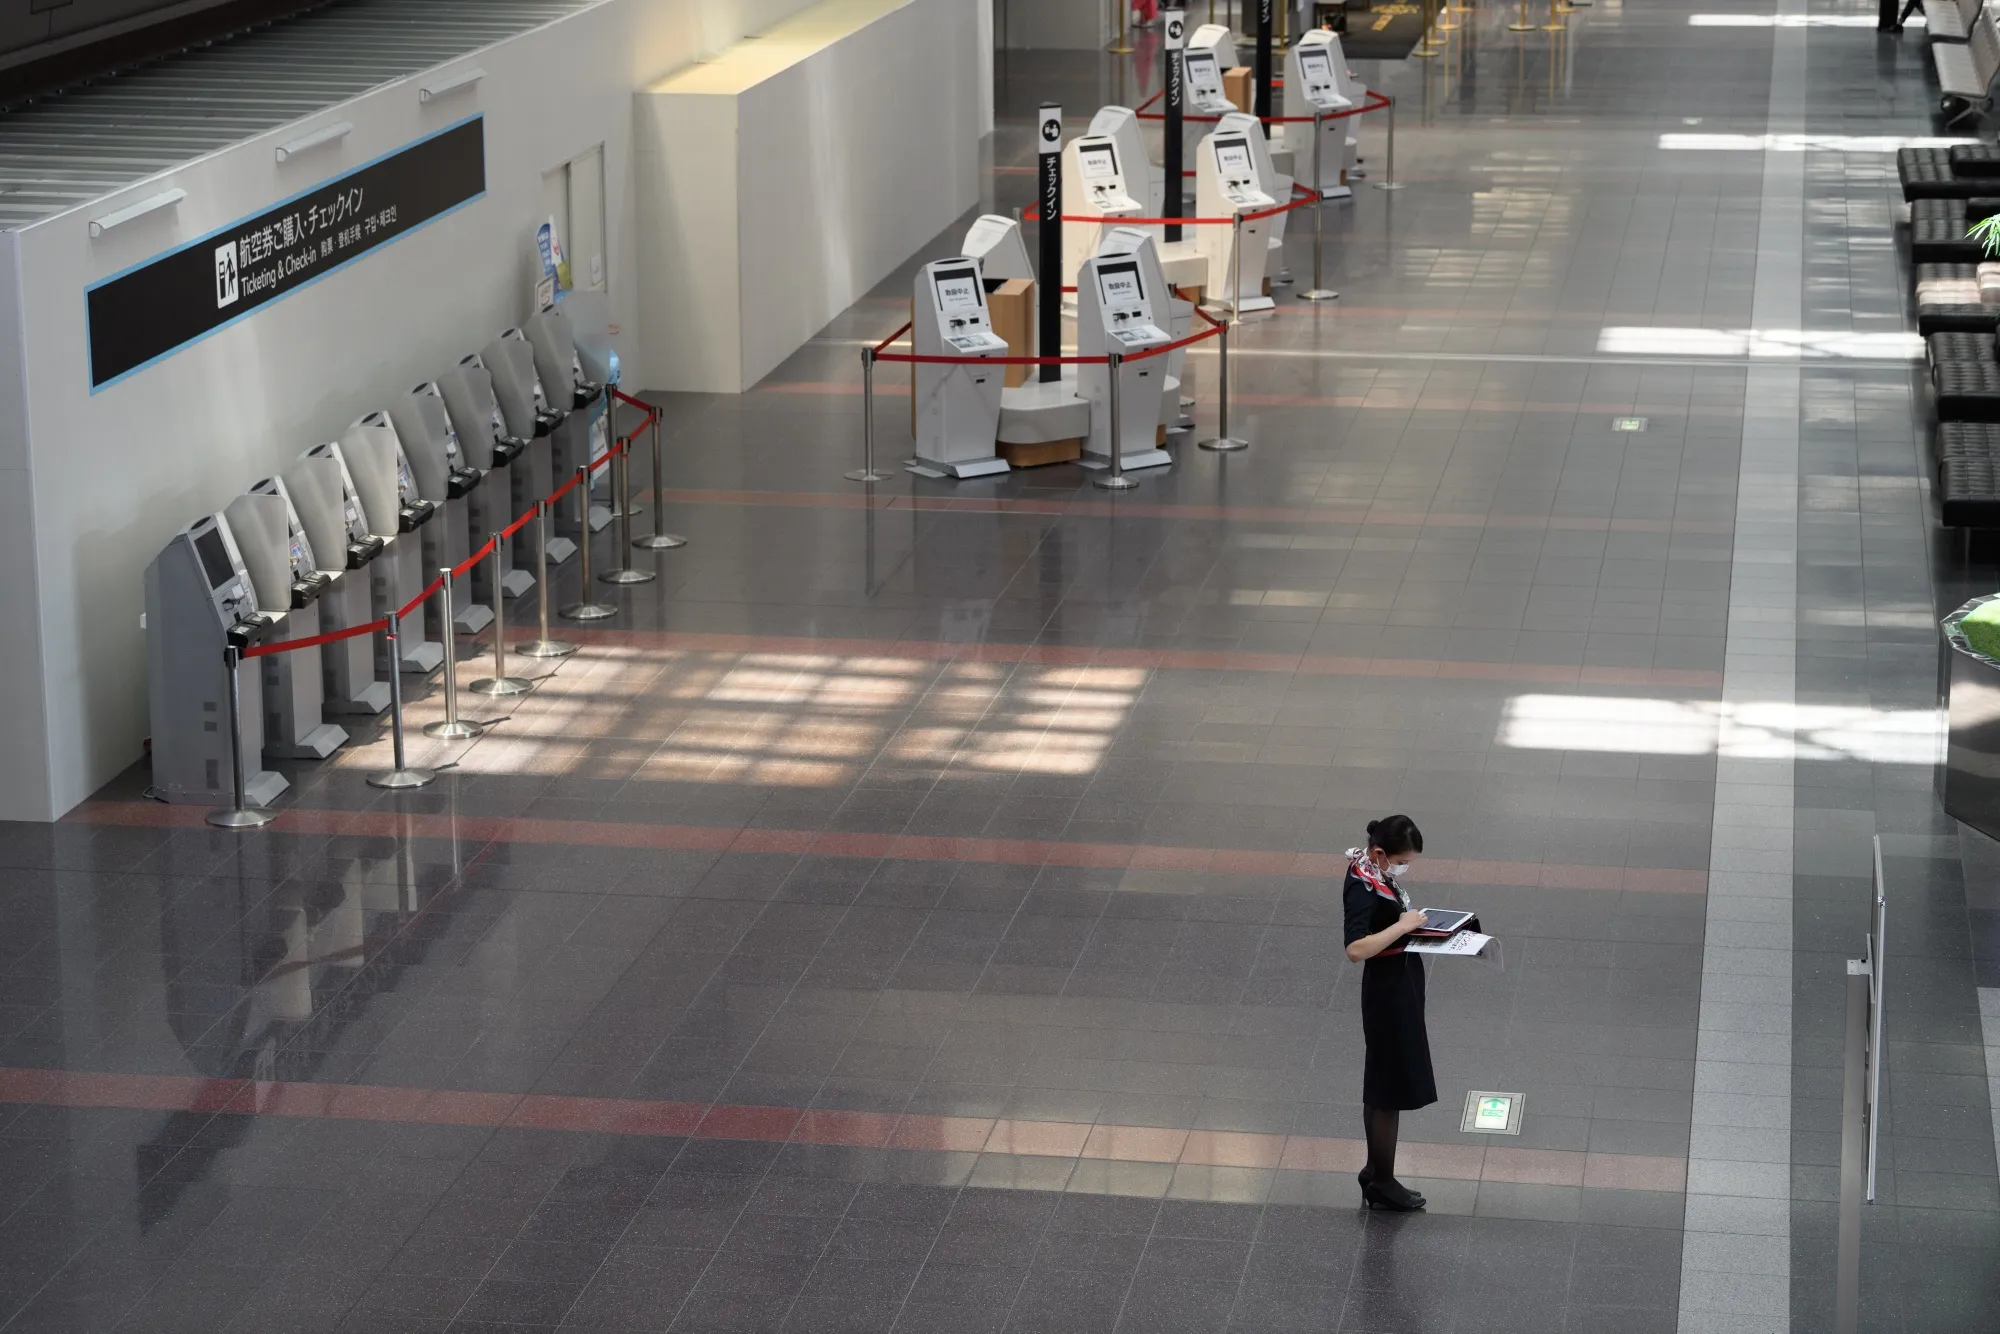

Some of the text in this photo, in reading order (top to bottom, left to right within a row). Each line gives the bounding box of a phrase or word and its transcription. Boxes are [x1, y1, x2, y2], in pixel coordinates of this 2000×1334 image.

[1046, 157, 1057, 220] チェックイン
[241, 246, 317, 297] Ticketing & Check-in
